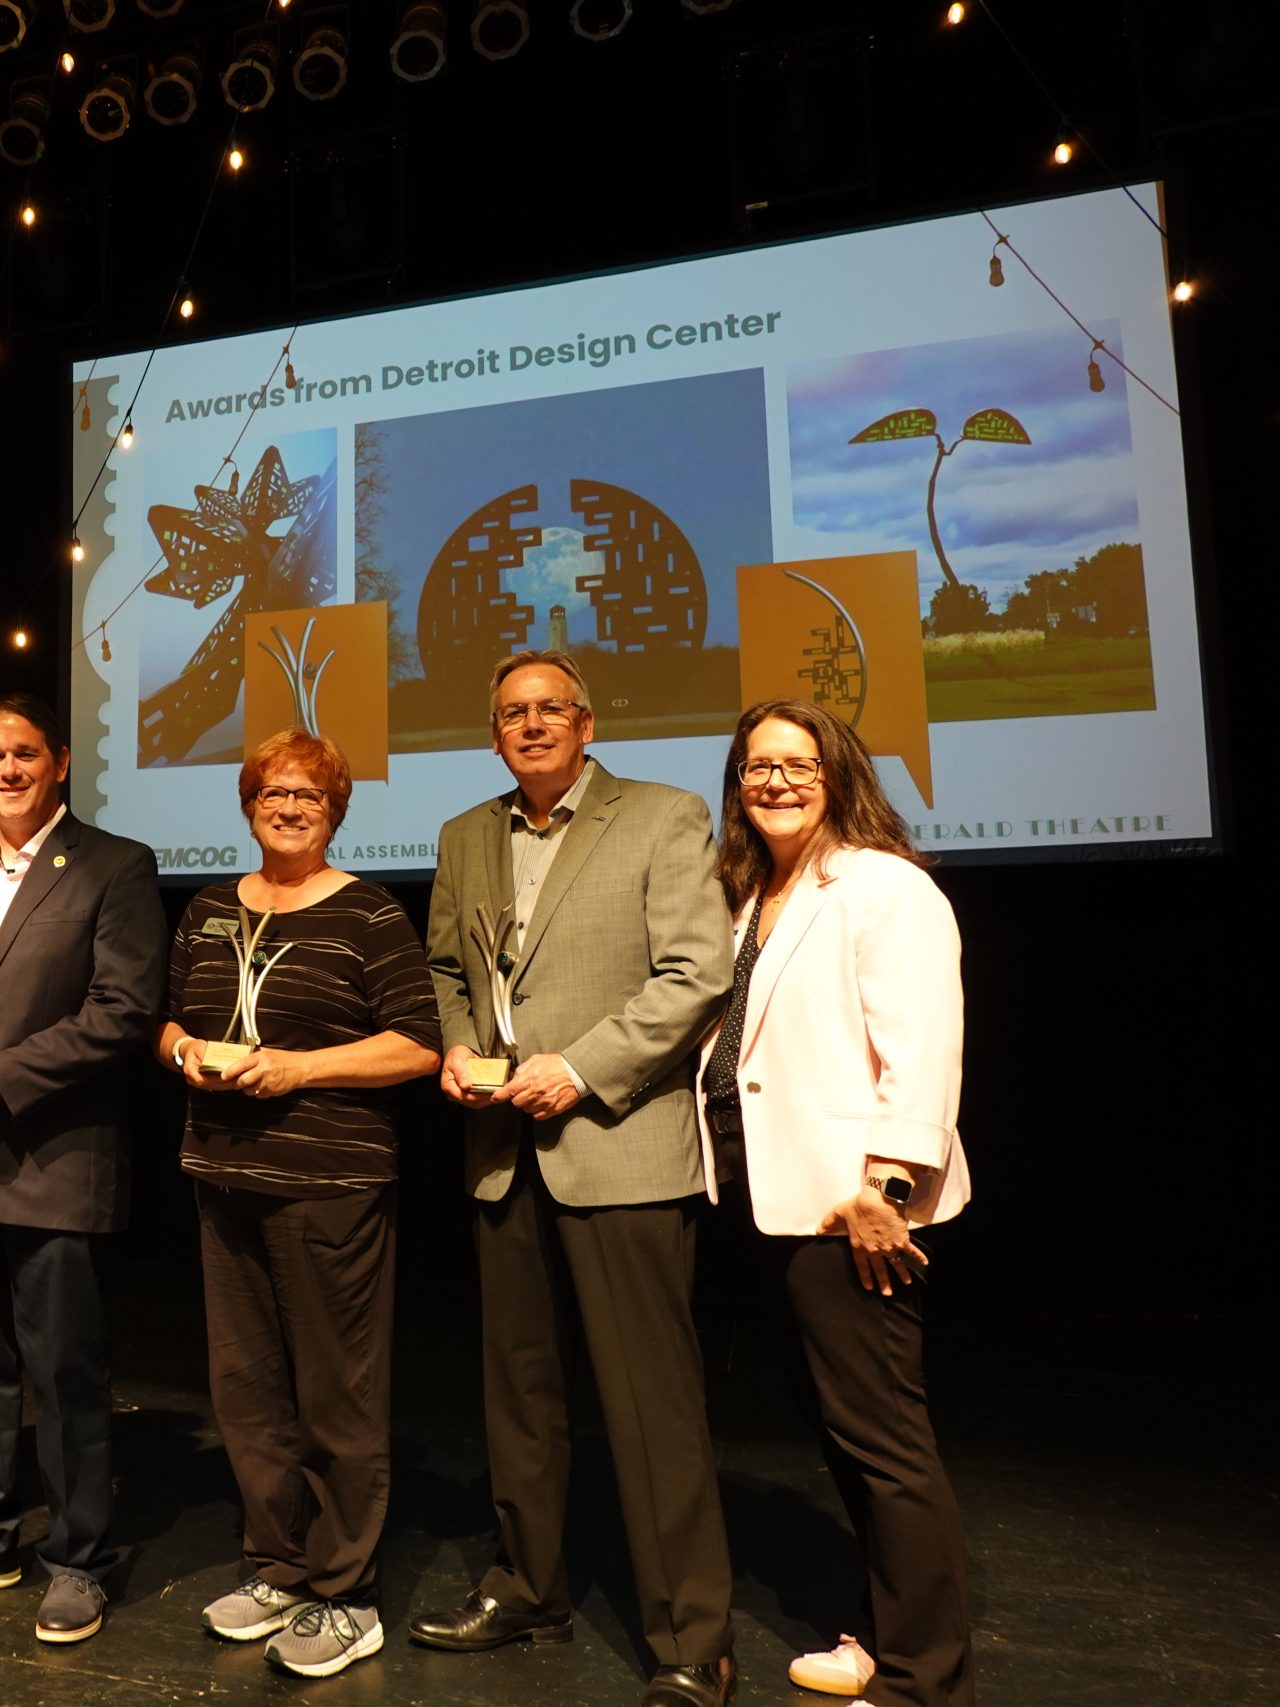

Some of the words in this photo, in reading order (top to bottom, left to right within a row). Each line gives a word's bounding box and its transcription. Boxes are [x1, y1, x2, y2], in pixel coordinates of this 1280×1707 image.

[165, 384, 286, 423] Awards
[293, 373, 373, 404] from
[381, 348, 501, 391] Detroit
[509, 333, 637, 369] Design
[646, 309, 782, 350] Center
[912, 821, 1015, 841] ERALD
[1024, 814, 1174, 837] THEATRE
[353, 843, 440, 859] ASSEMBL
